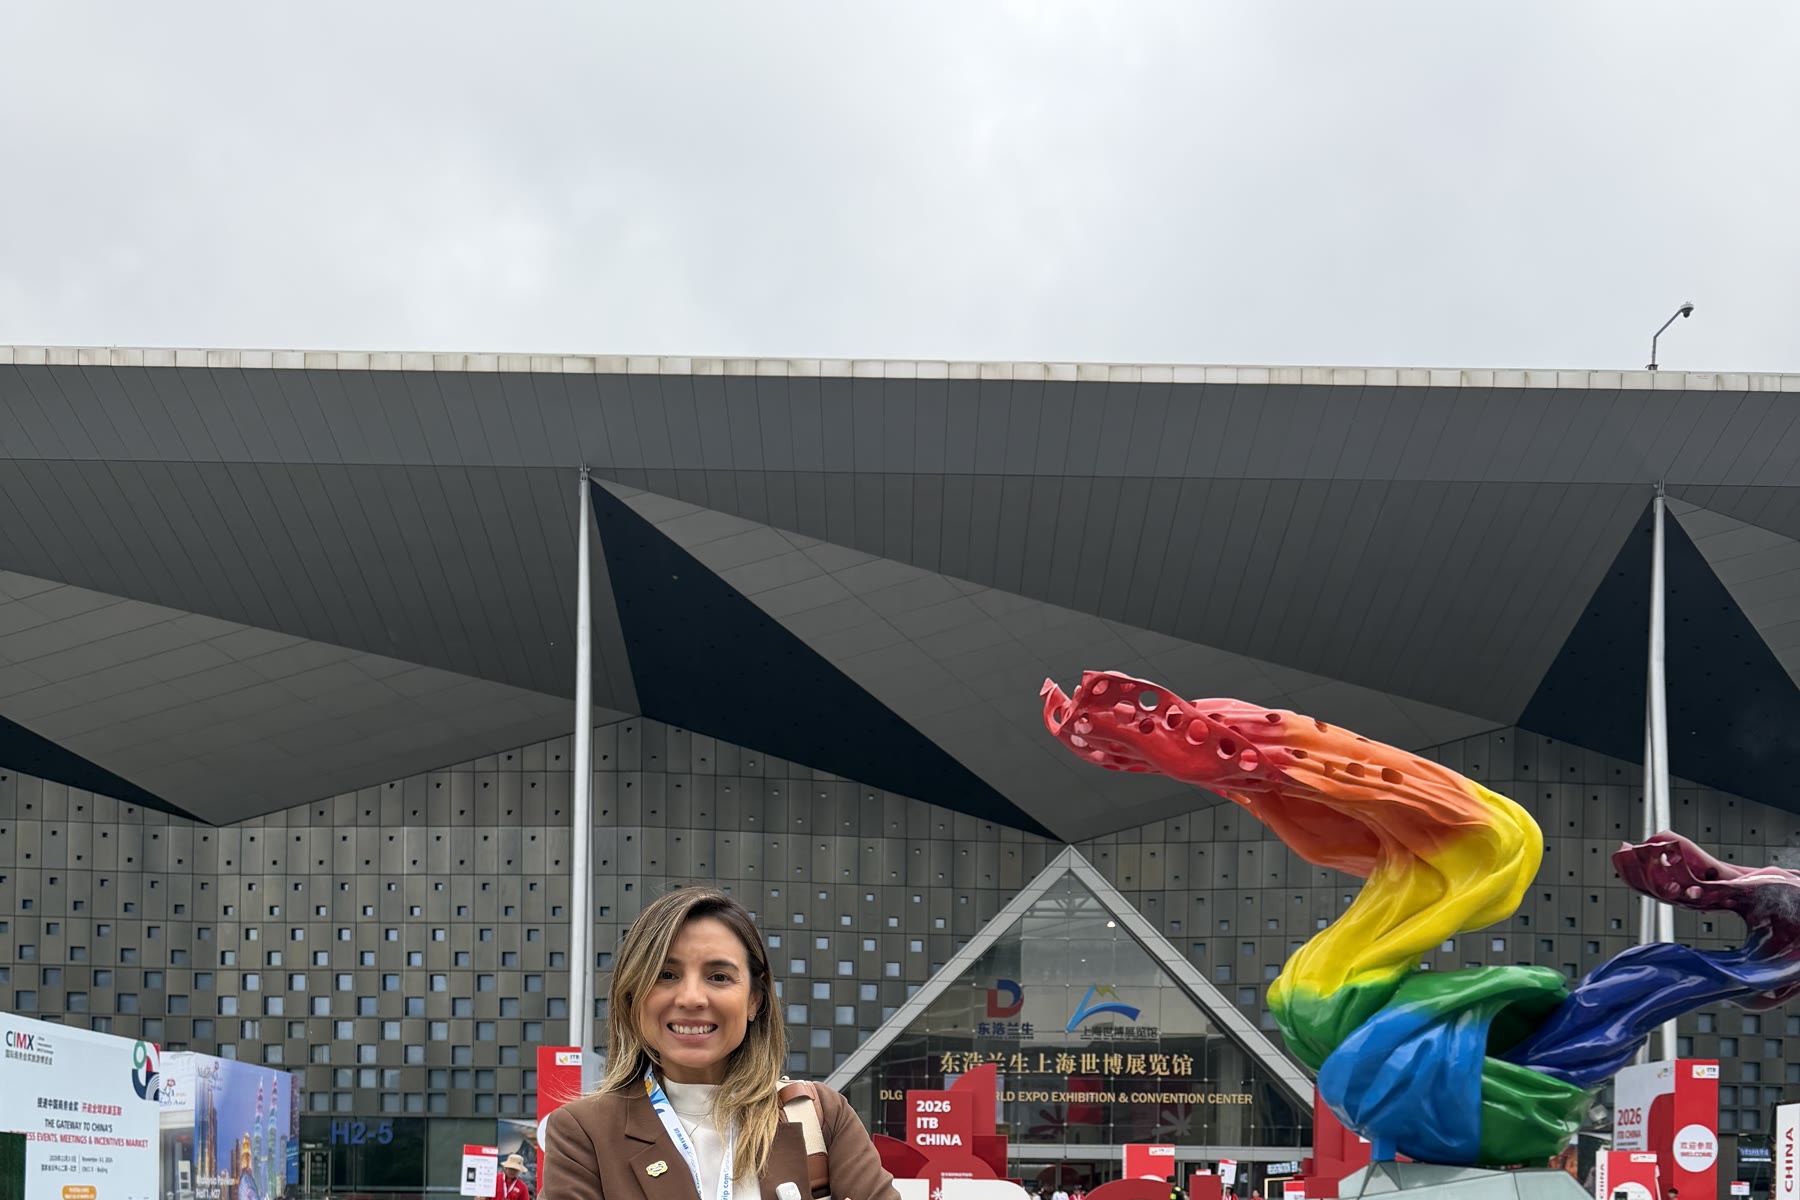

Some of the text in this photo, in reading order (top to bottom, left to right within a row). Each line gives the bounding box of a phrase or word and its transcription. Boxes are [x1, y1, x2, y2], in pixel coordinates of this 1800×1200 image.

[977, 1022, 1034, 1036] 东浩兰生
[1080, 1026, 1158, 1038] 上海世博展览馆
[5, 1030, 35, 1051] CIMX
[940, 1051, 1194, 1077] 东浩兰生上海世博展览馆
[880, 1089, 903, 1101] DLG
[1018, 1091, 1049, 1102] EXPO
[1051, 1091, 1116, 1103] EXHIBITION
[1118, 1092, 1128, 1103] &
[1130, 1092, 1205, 1104] CONVENTION
[1207, 1093, 1253, 1104] CENTER
[916, 1100, 951, 1113] 2026
[916, 1117, 939, 1129] ITB
[1617, 1107, 1642, 1127] 2026
[44, 1118, 55, 1128] THE
[56, 1119, 82, 1130] GATEWAY
[83, 1121, 90, 1131] TO
[330, 1121, 394, 1145] H2-5
[916, 1133, 962, 1146] CHINA
[1624, 1129, 1641, 1139] CHINA
[60, 1133, 87, 1144] MEETINGS
[125, 1138, 149, 1148] MARKET
[1784, 1127, 1794, 1193] CHINA
